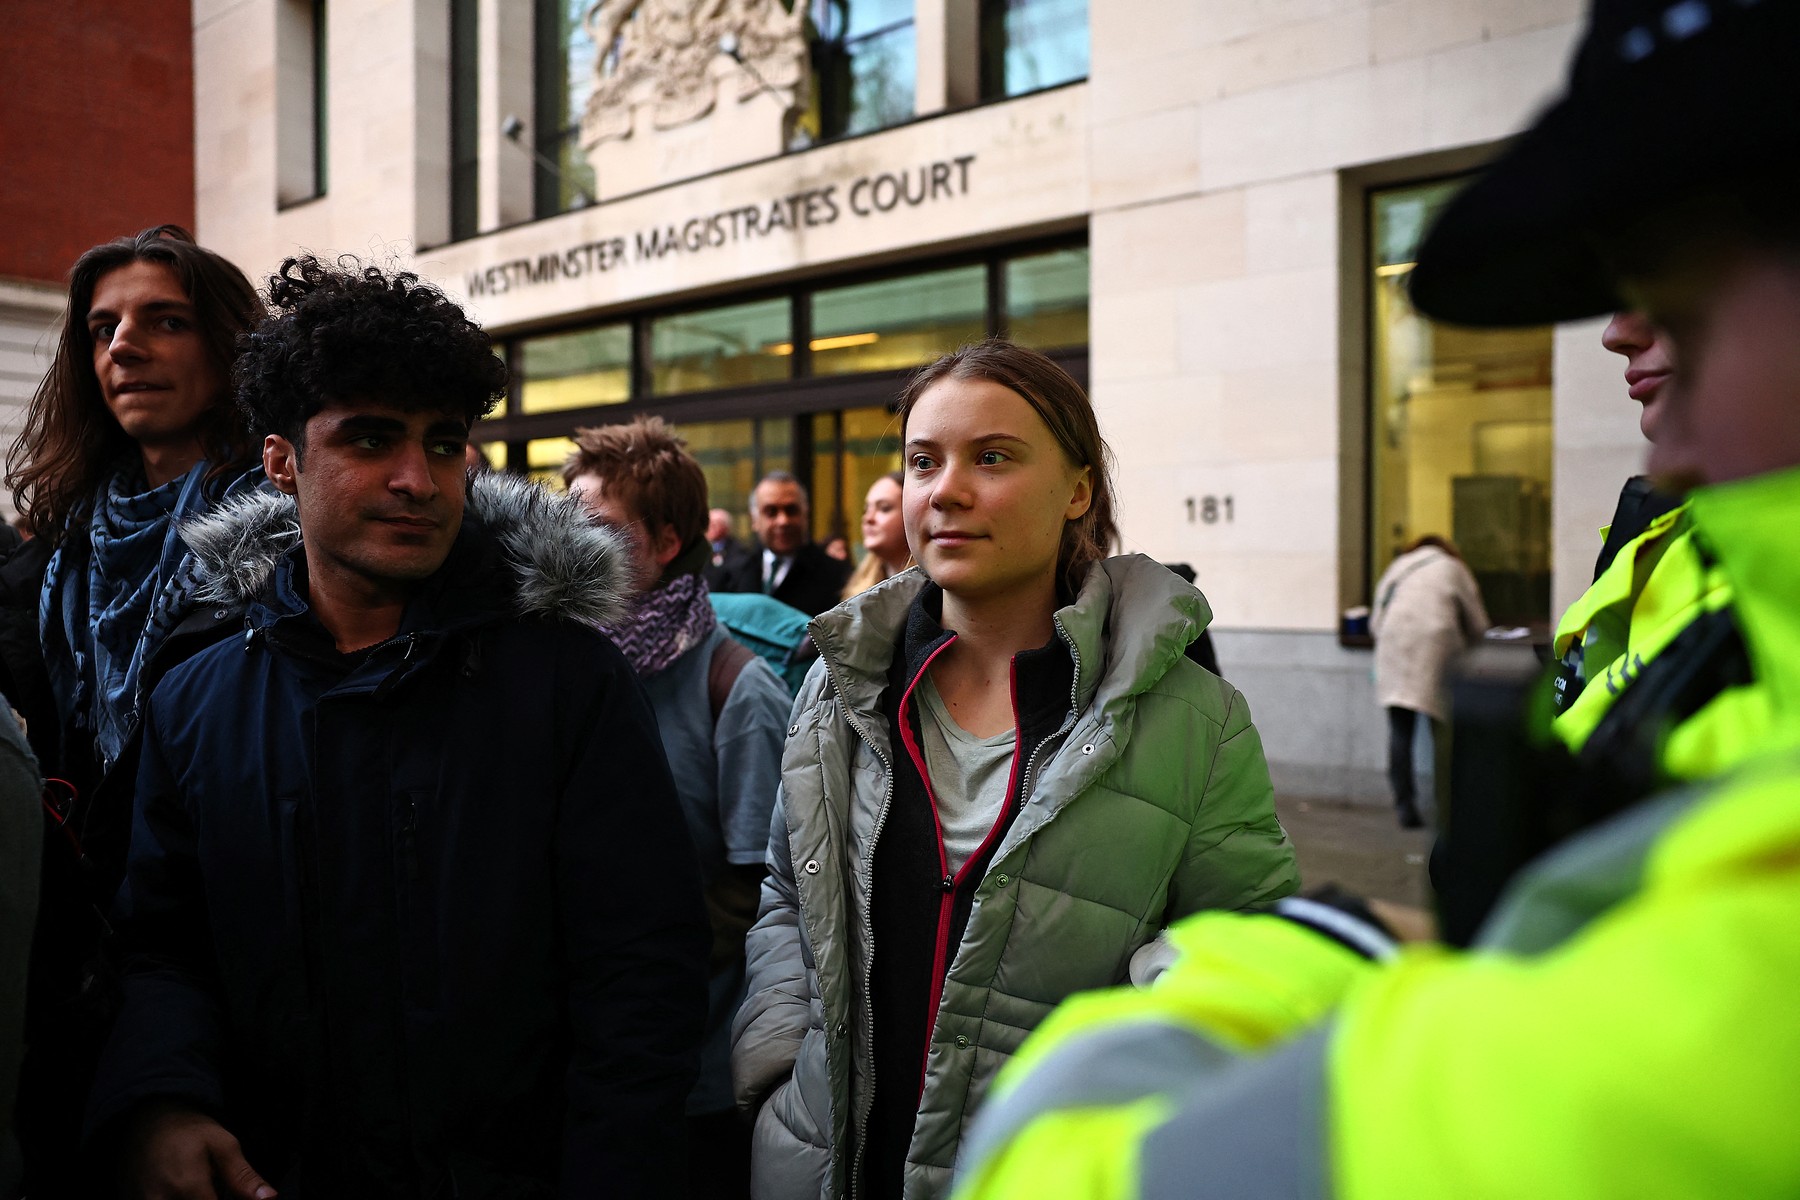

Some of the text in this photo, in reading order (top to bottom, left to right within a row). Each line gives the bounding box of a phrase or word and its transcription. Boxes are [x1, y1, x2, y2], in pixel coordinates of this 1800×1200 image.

[467, 154, 977, 298] WESTMINSTER MAGISTRATES COURT
[1184, 495, 1235, 525] 181
